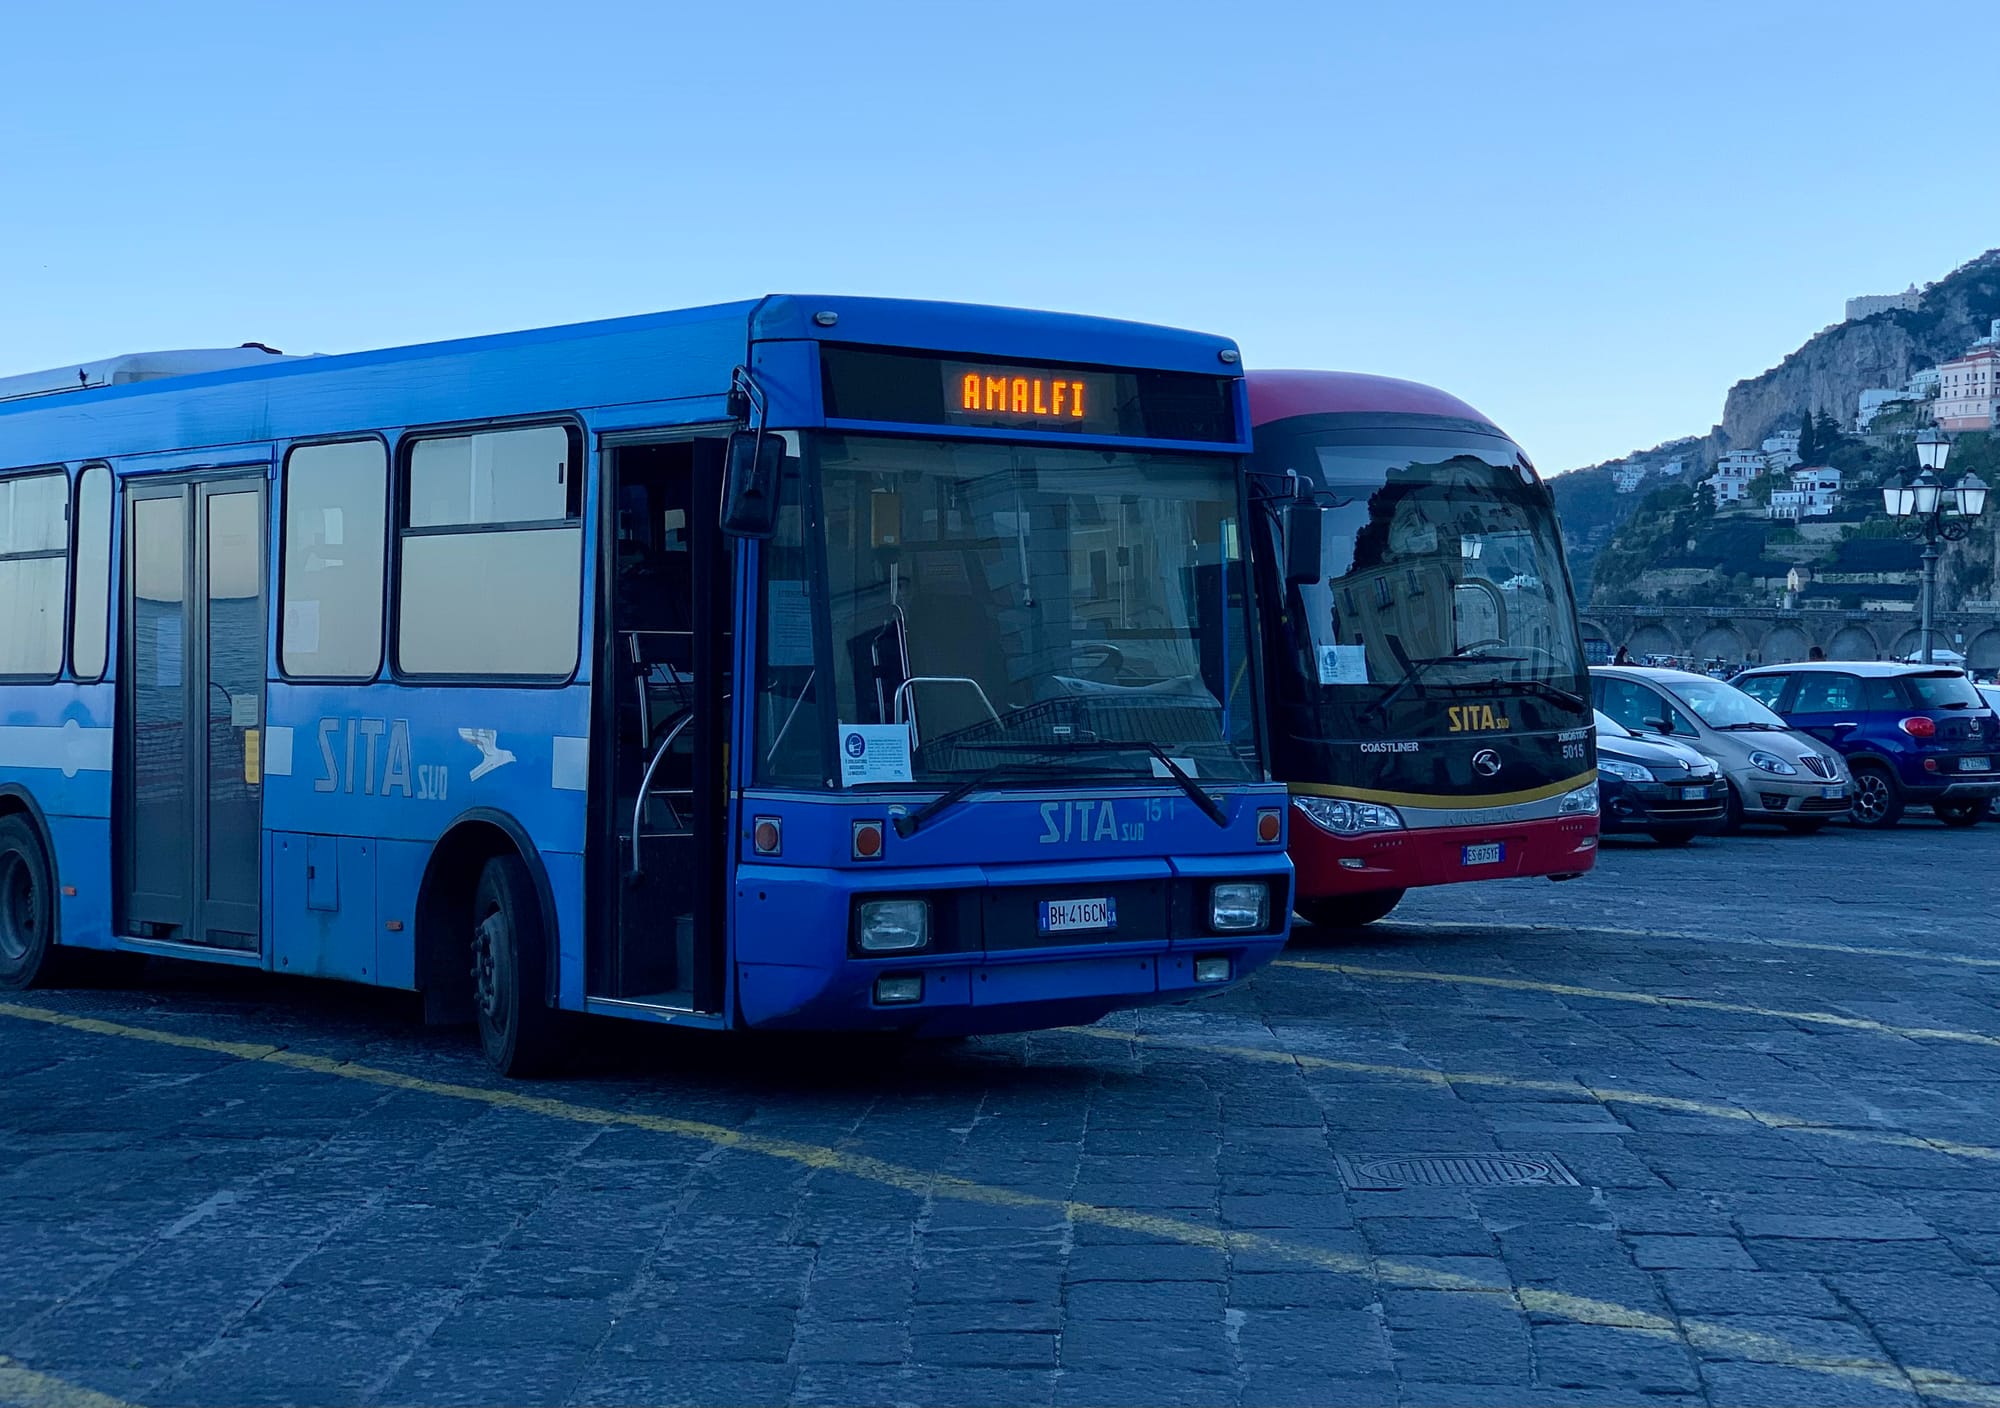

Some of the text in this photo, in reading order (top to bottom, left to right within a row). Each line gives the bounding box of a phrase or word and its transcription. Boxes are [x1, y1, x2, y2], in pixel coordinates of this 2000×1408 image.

[963, 374, 1083, 416] AMALFI
[1448, 705, 1495, 732] SITA
[314, 717, 412, 798] SITA
[416, 764, 448, 800] SUD
[1360, 742, 1419, 753] COASTLINER
[1562, 743, 1584, 759] 5015
[1039, 800, 1144, 843] SITA SUD
